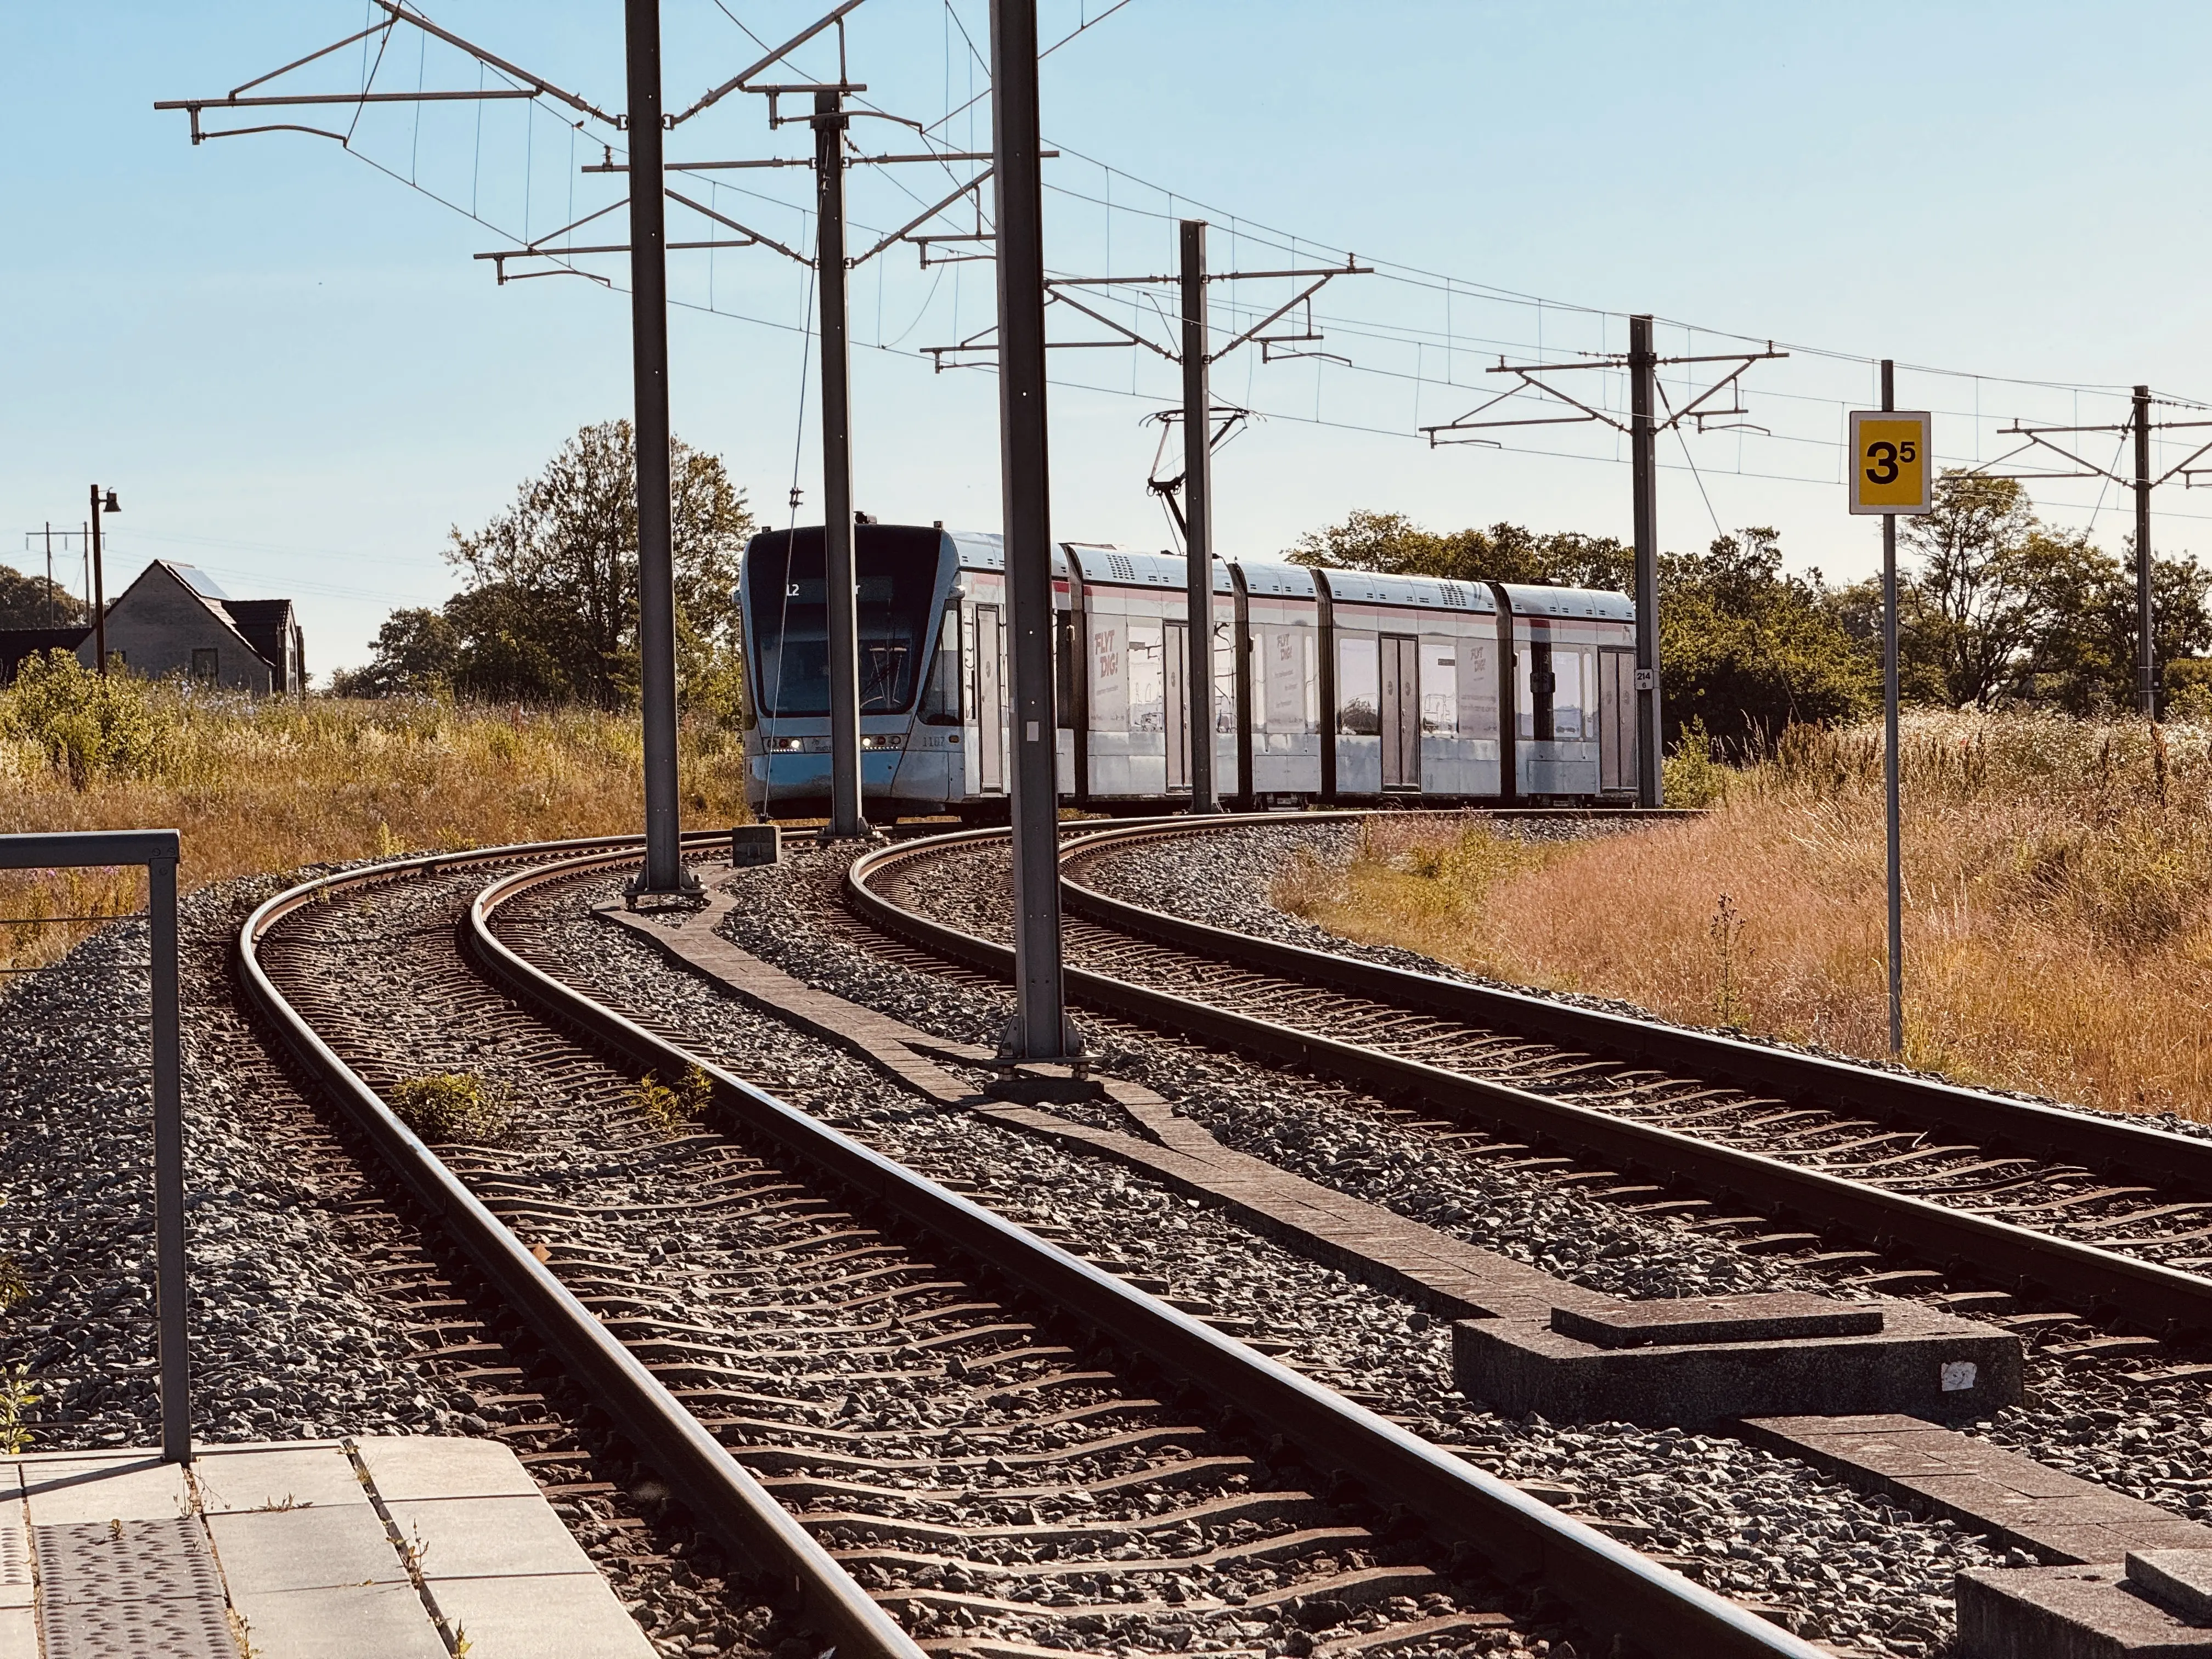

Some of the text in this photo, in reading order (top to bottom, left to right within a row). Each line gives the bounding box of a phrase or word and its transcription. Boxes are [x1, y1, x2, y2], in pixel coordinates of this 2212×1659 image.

[786, 584, 799, 596] L2
[1094, 630, 1115, 655] FLYT
[1100, 652, 1119, 678] DIG!
[1637, 672, 1651, 680] 214
